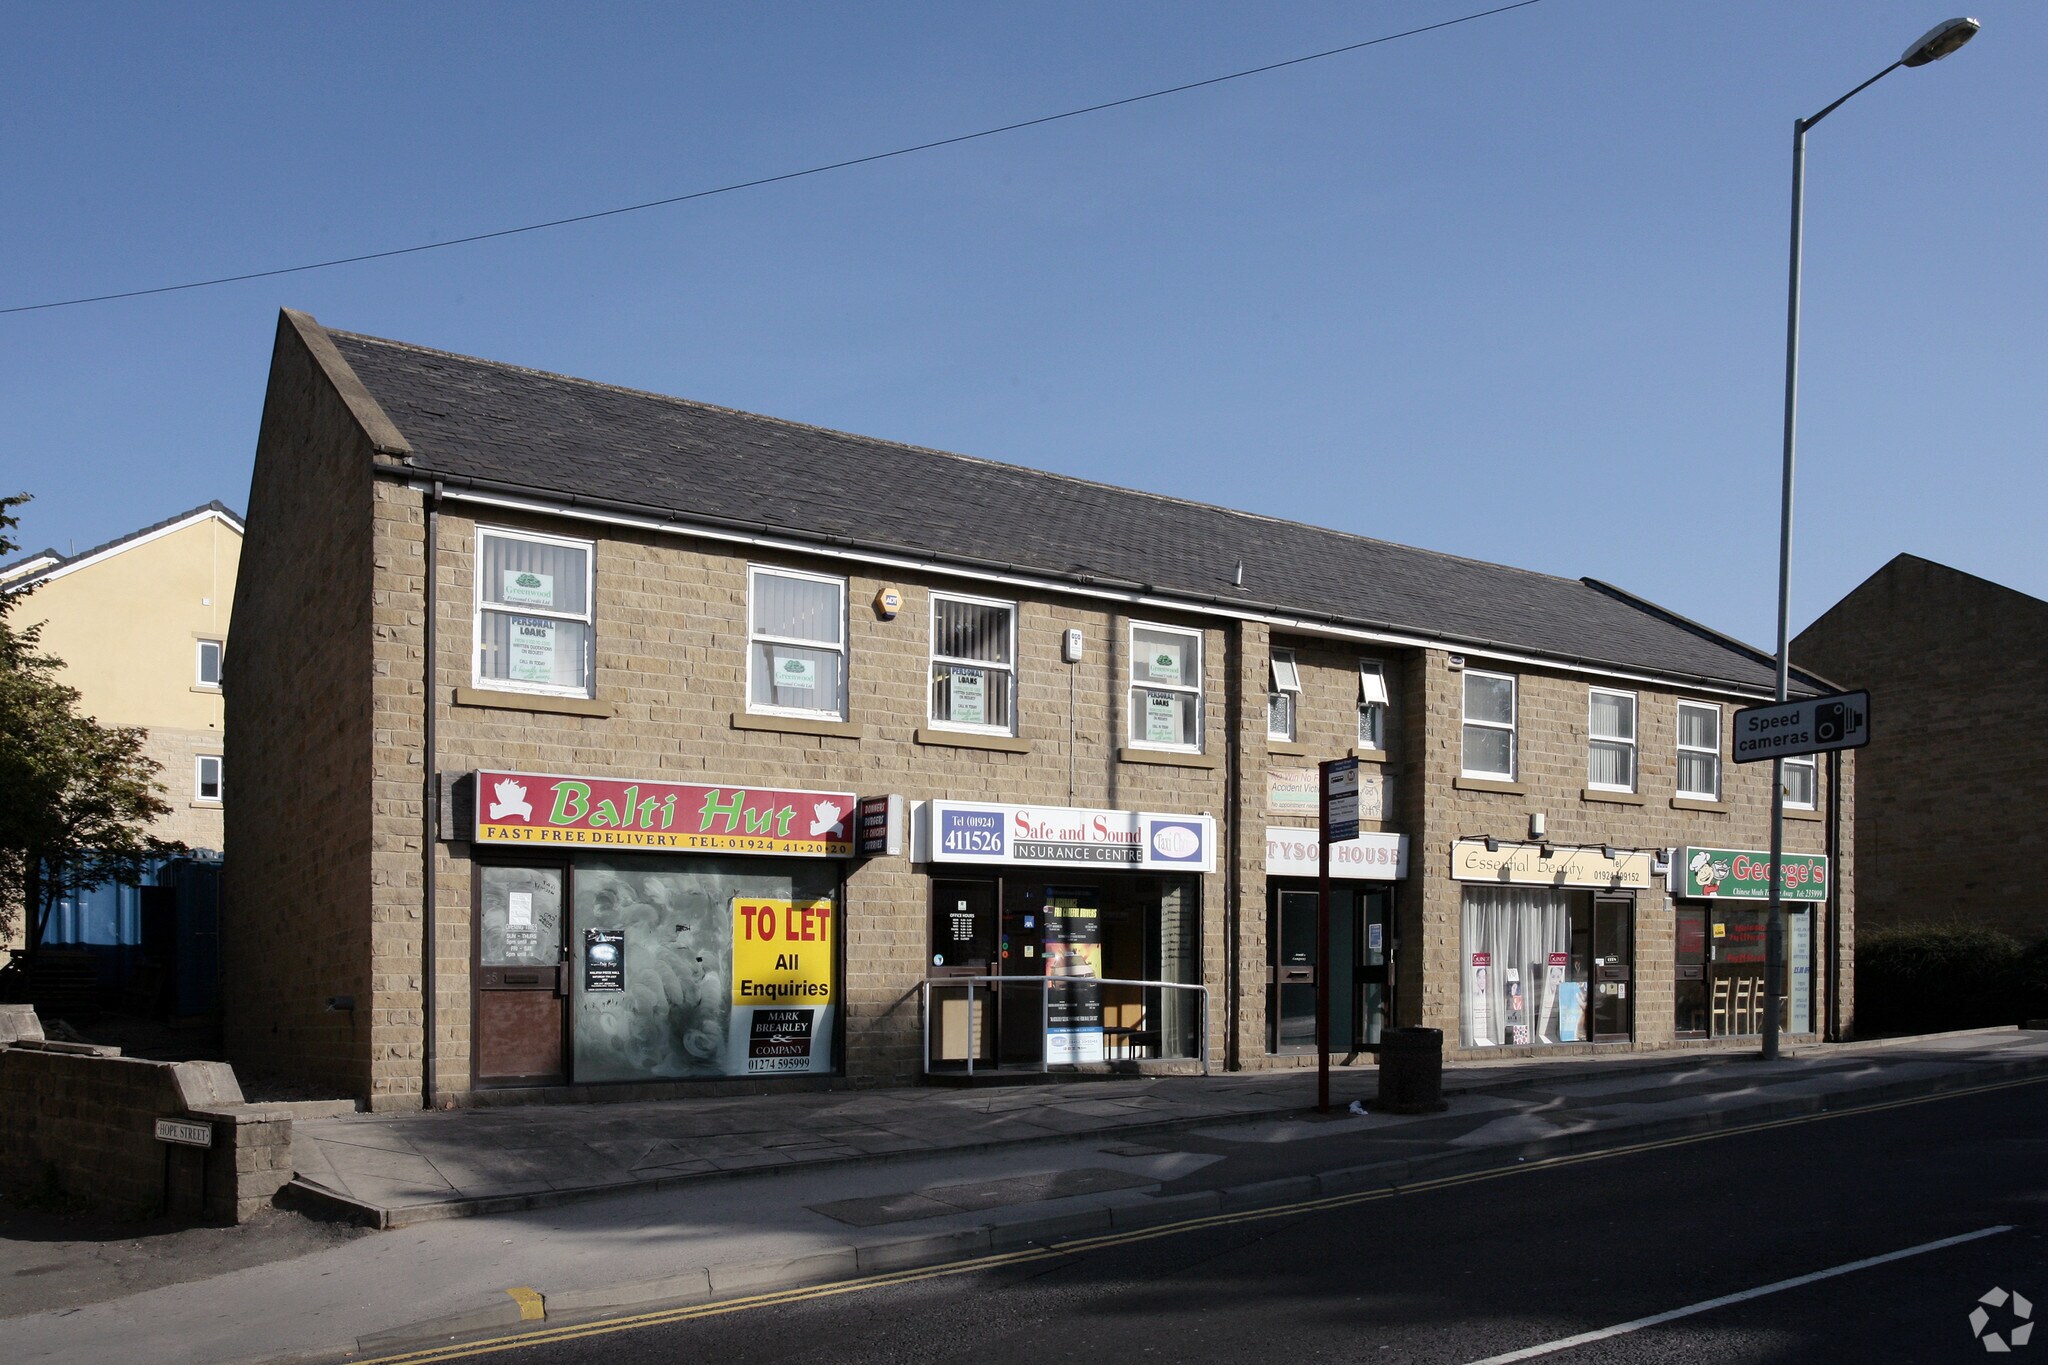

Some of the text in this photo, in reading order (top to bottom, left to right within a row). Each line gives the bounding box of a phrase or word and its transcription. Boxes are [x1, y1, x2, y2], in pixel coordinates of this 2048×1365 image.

[505, 585, 552, 598] Greenwood
[512, 617, 554, 629] PERSONAL
[520, 627, 546, 637] LOANS
[776, 671, 814, 682] Greenwood
[958, 676, 977, 685] LOANS
[1152, 699, 1169, 707] LOANS
[1749, 710, 1800, 732] Speed
[1739, 731, 1809, 751] cameras
[1287, 773, 1298, 781] Win
[1301, 774, 1311, 782] No
[1272, 783, 1302, 792] Accident
[549, 780, 797, 837] Balti Hut
[952, 815, 994, 828] Tel (01924)
[1014, 810, 1054, 840] Safe
[1059, 823, 1085, 841] and
[1093, 814, 1141, 844] Sound
[487, 827, 533, 839] FAST
[541, 829, 586, 842] FREE
[592, 831, 677, 846] DELIVERY
[689, 836, 724, 848] TEL:
[729, 838, 774, 851] 01924
[945, 830, 1000, 852] 411526
[1157, 832, 1171, 851] Taxi
[1014, 845, 1142, 862] INSURANCE CENTRE
[1266, 840, 1400, 865] TYSO HOUSE
[1465, 851, 1584, 881] Essential Beauty
[1733, 887, 1750, 895] Chinese
[1751, 888, 1764, 896] Meals
[1054, 907, 1062, 917] FOR
[741, 906, 830, 941] TO LET
[775, 954, 799, 970] All
[741, 980, 829, 1000] Enquiries
[768, 1012, 799, 1021] MARK
[756, 1022, 808, 1032] BREARLEY
[770, 1034, 795, 1043] &
[756, 1045, 803, 1055] COMPANY
[749, 1058, 810, 1070] 01274 595999
[160, 1124, 206, 1141] HOPE STREET
